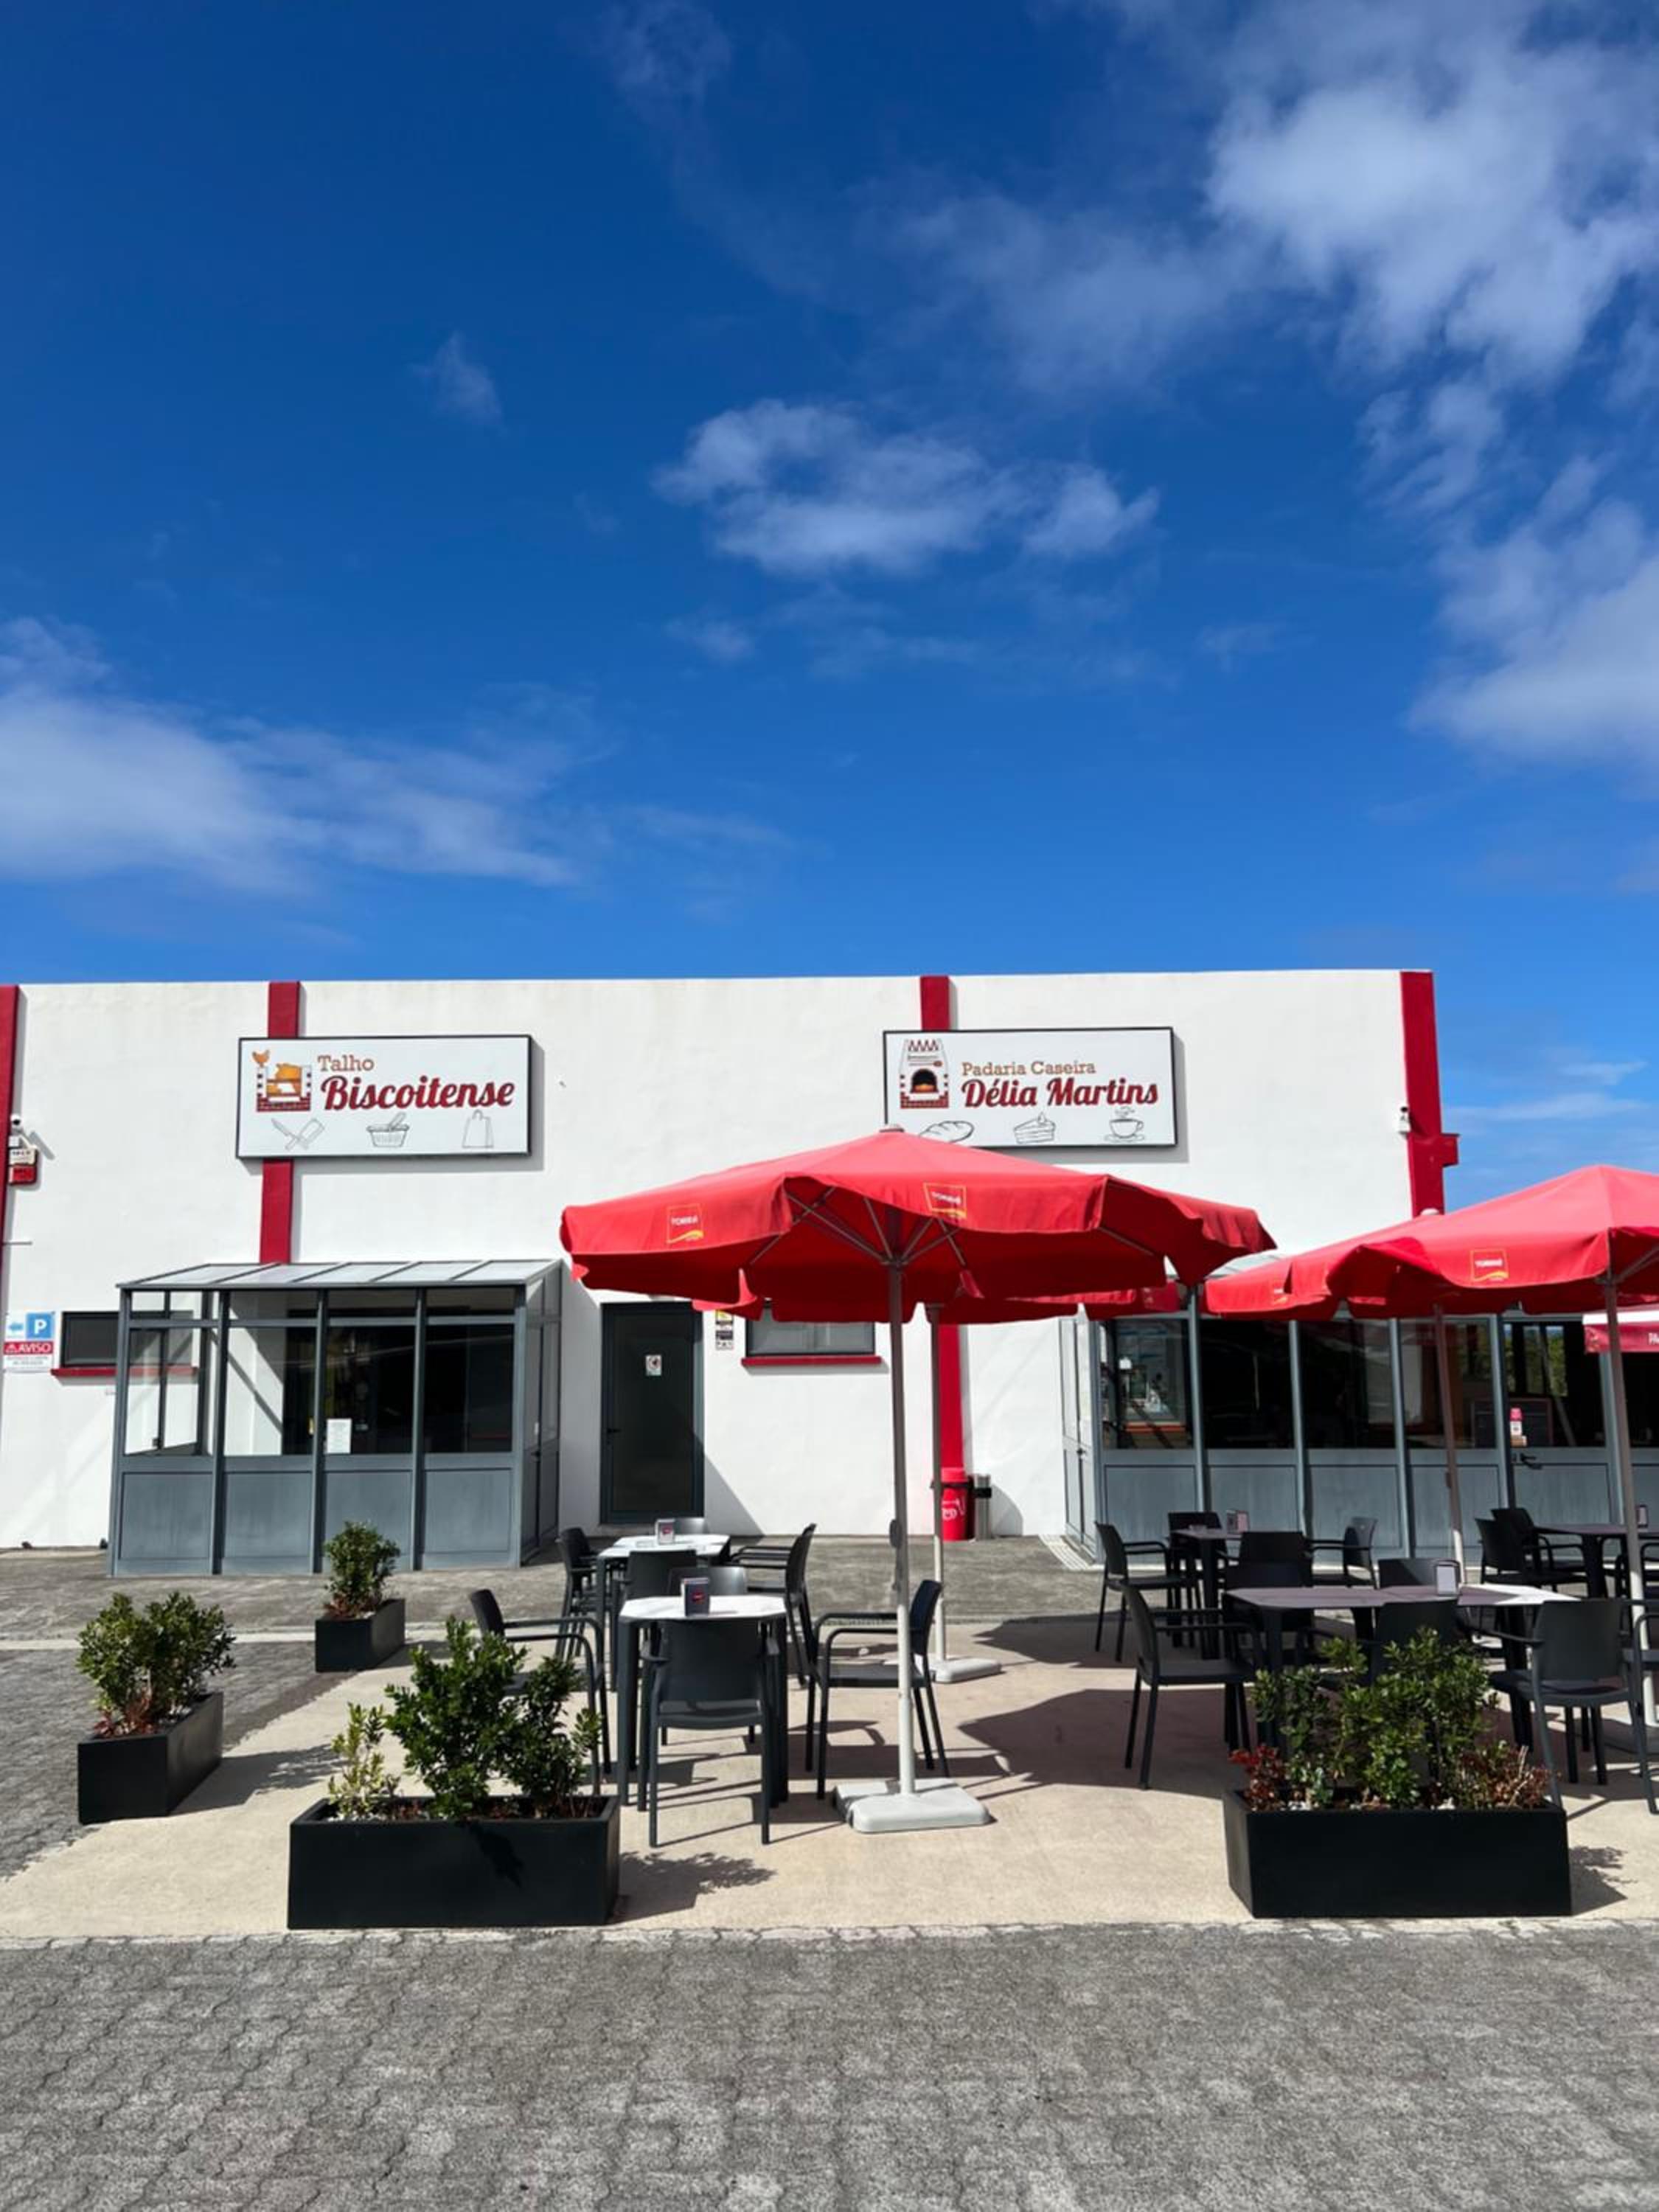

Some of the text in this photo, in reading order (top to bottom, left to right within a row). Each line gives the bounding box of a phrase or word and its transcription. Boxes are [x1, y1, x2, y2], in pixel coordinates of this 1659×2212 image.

[317, 1054, 375, 1072] Talho
[961, 1060, 1097, 1077] Padaria Caseira
[320, 1075, 515, 1111] Biscoitense
[961, 1077, 1158, 1108] Délia Martins
[33, 1319, 47, 1335] P
[19, 1343, 52, 1353] AVISO
